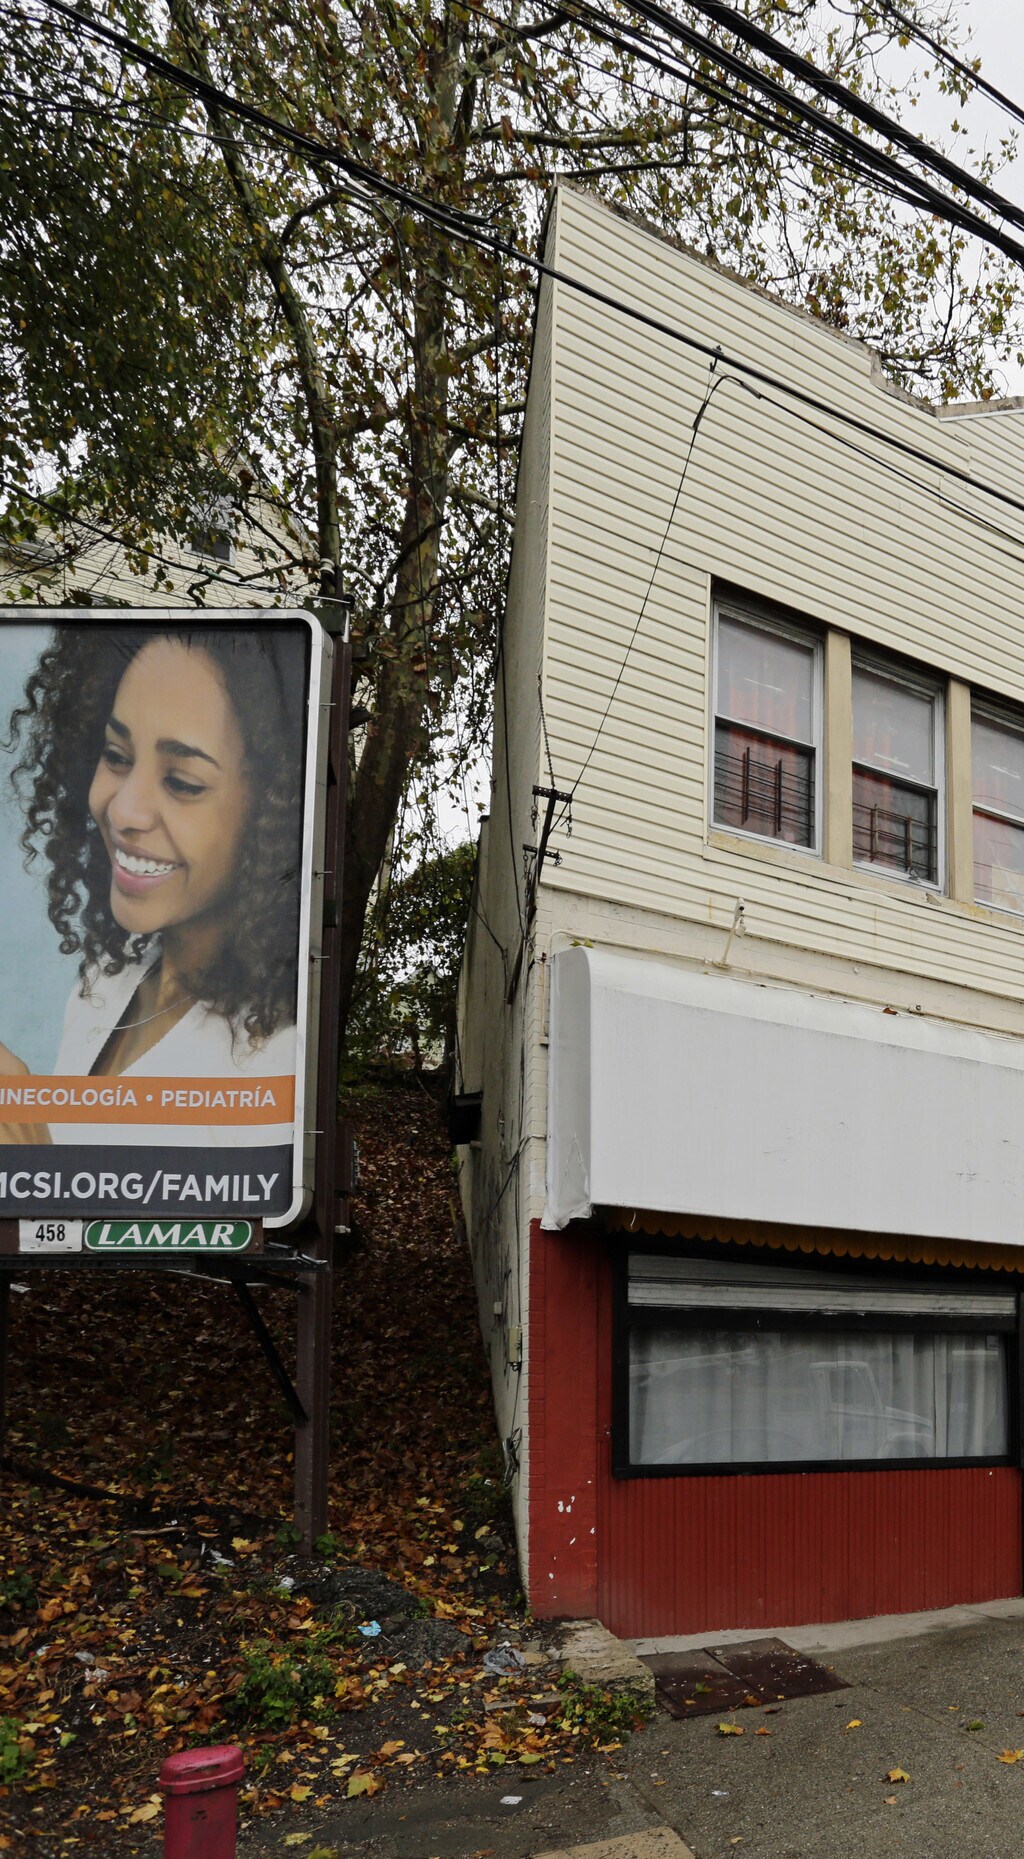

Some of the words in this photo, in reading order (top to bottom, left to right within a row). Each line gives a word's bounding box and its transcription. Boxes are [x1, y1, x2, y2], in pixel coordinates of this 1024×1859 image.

[0, 1085, 138, 1106] INECOLOGÍA
[161, 1085, 276, 1108] PEDIATRÍA
[0, 1170, 279, 1204] CSI.ORG/FAMILY
[35, 1223, 66, 1242] 458
[98, 1223, 235, 1246] LAMAR
